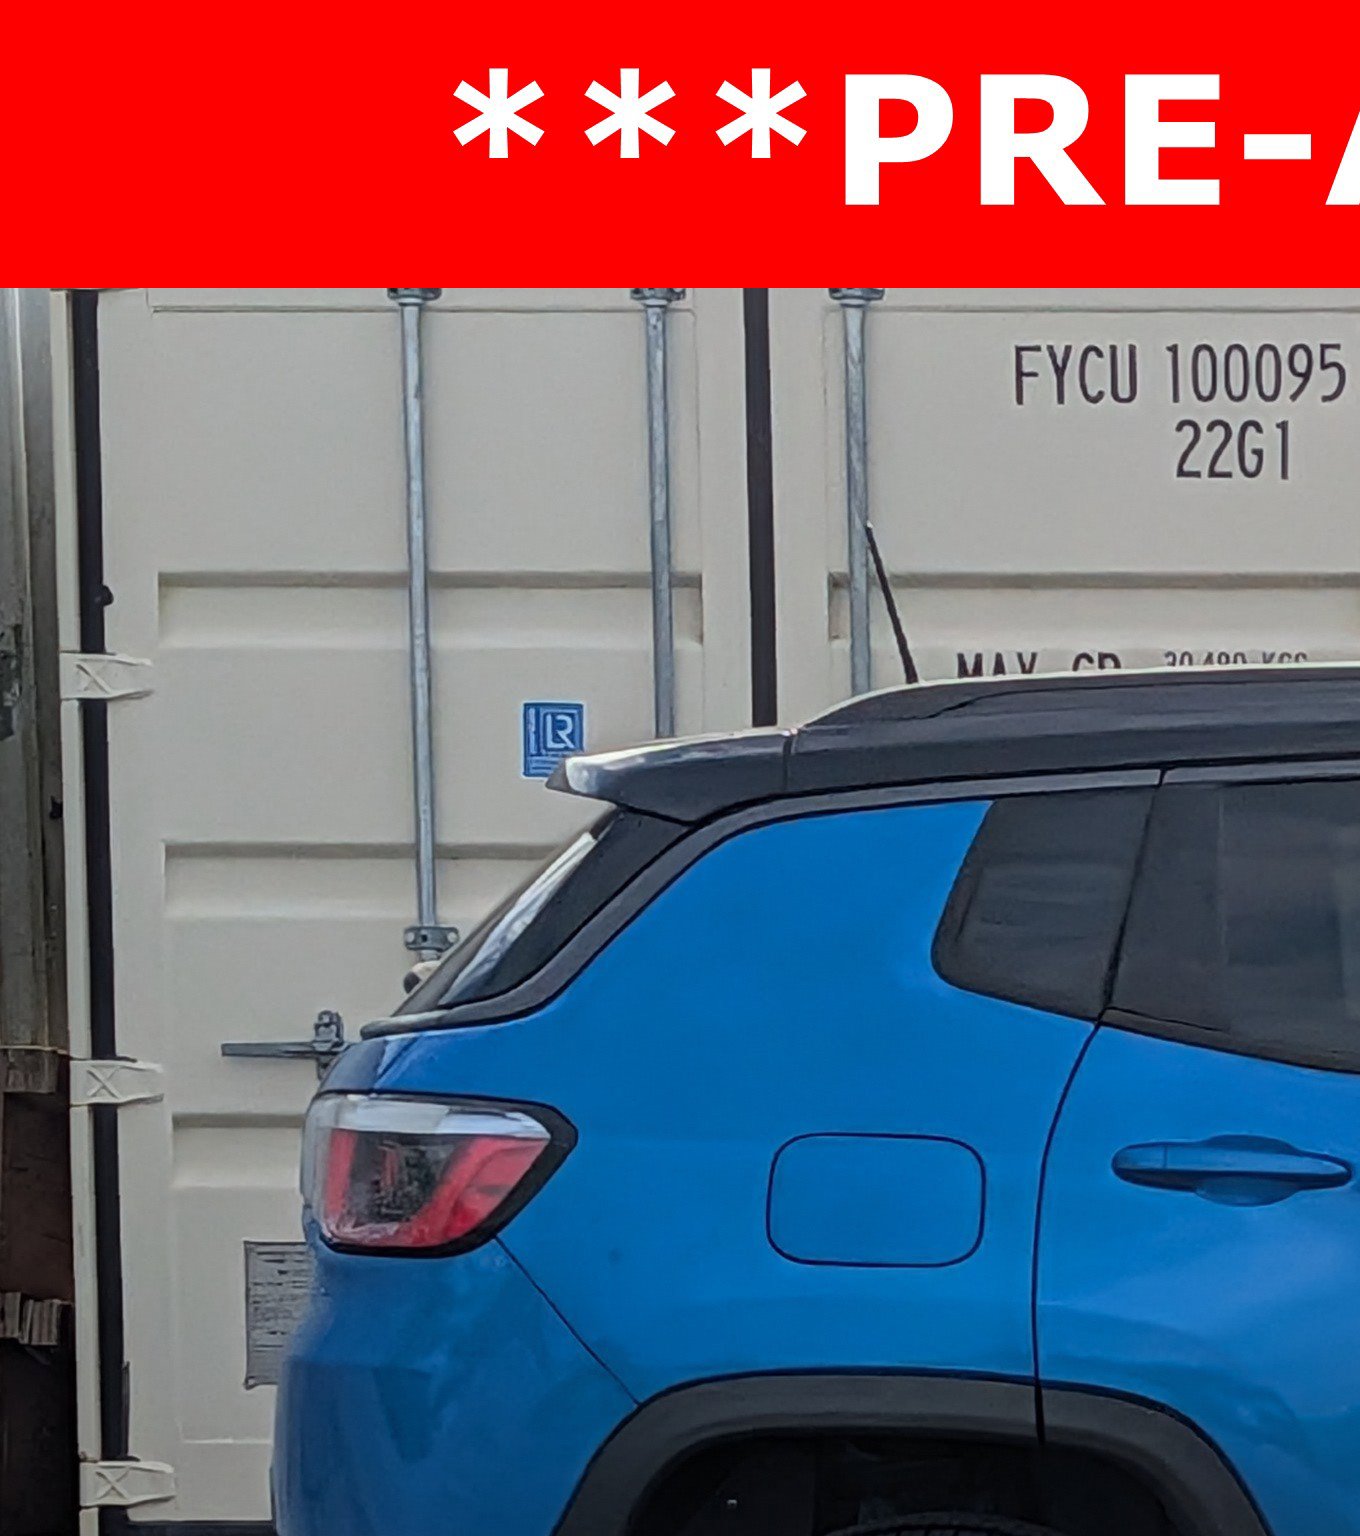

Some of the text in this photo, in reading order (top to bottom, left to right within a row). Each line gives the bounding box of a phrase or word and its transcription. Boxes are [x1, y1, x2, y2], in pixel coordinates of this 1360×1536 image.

[1015, 344, 1138, 405] FYCU
[1166, 343, 1347, 403] 100095
[1174, 419, 1290, 481] 22G1
